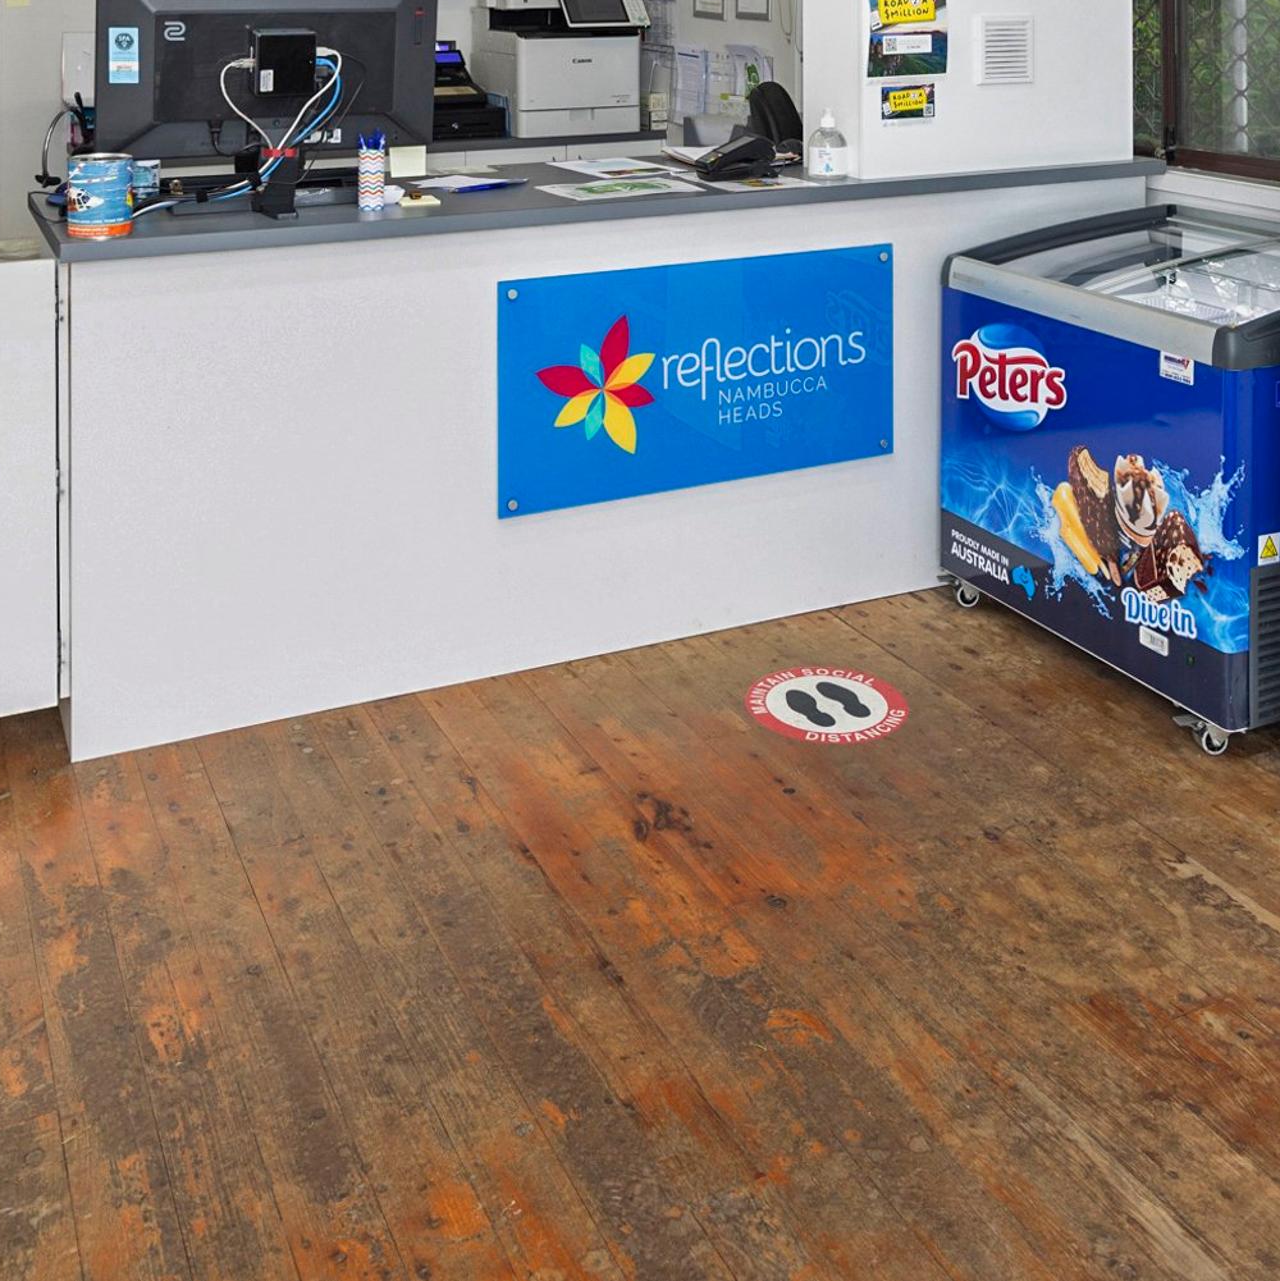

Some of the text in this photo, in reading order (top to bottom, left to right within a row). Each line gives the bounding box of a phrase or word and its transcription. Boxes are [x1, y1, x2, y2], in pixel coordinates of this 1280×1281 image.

[885, 7, 929, 20] $MILLION
[662, 328, 866, 401] reflections
[953, 341, 1066, 408] Peters
[718, 375, 828, 407] NAMBUCCA
[718, 401, 783, 426] HEADS
[951, 529, 1009, 567] PROUDLY MADE IN
[951, 541, 1009, 585] AUSTRALIA
[1122, 588, 1196, 637] Dive in
[749, 668, 874, 715] MAINTAIN SOCIAL
[805, 708, 906, 743] DISTANCING
